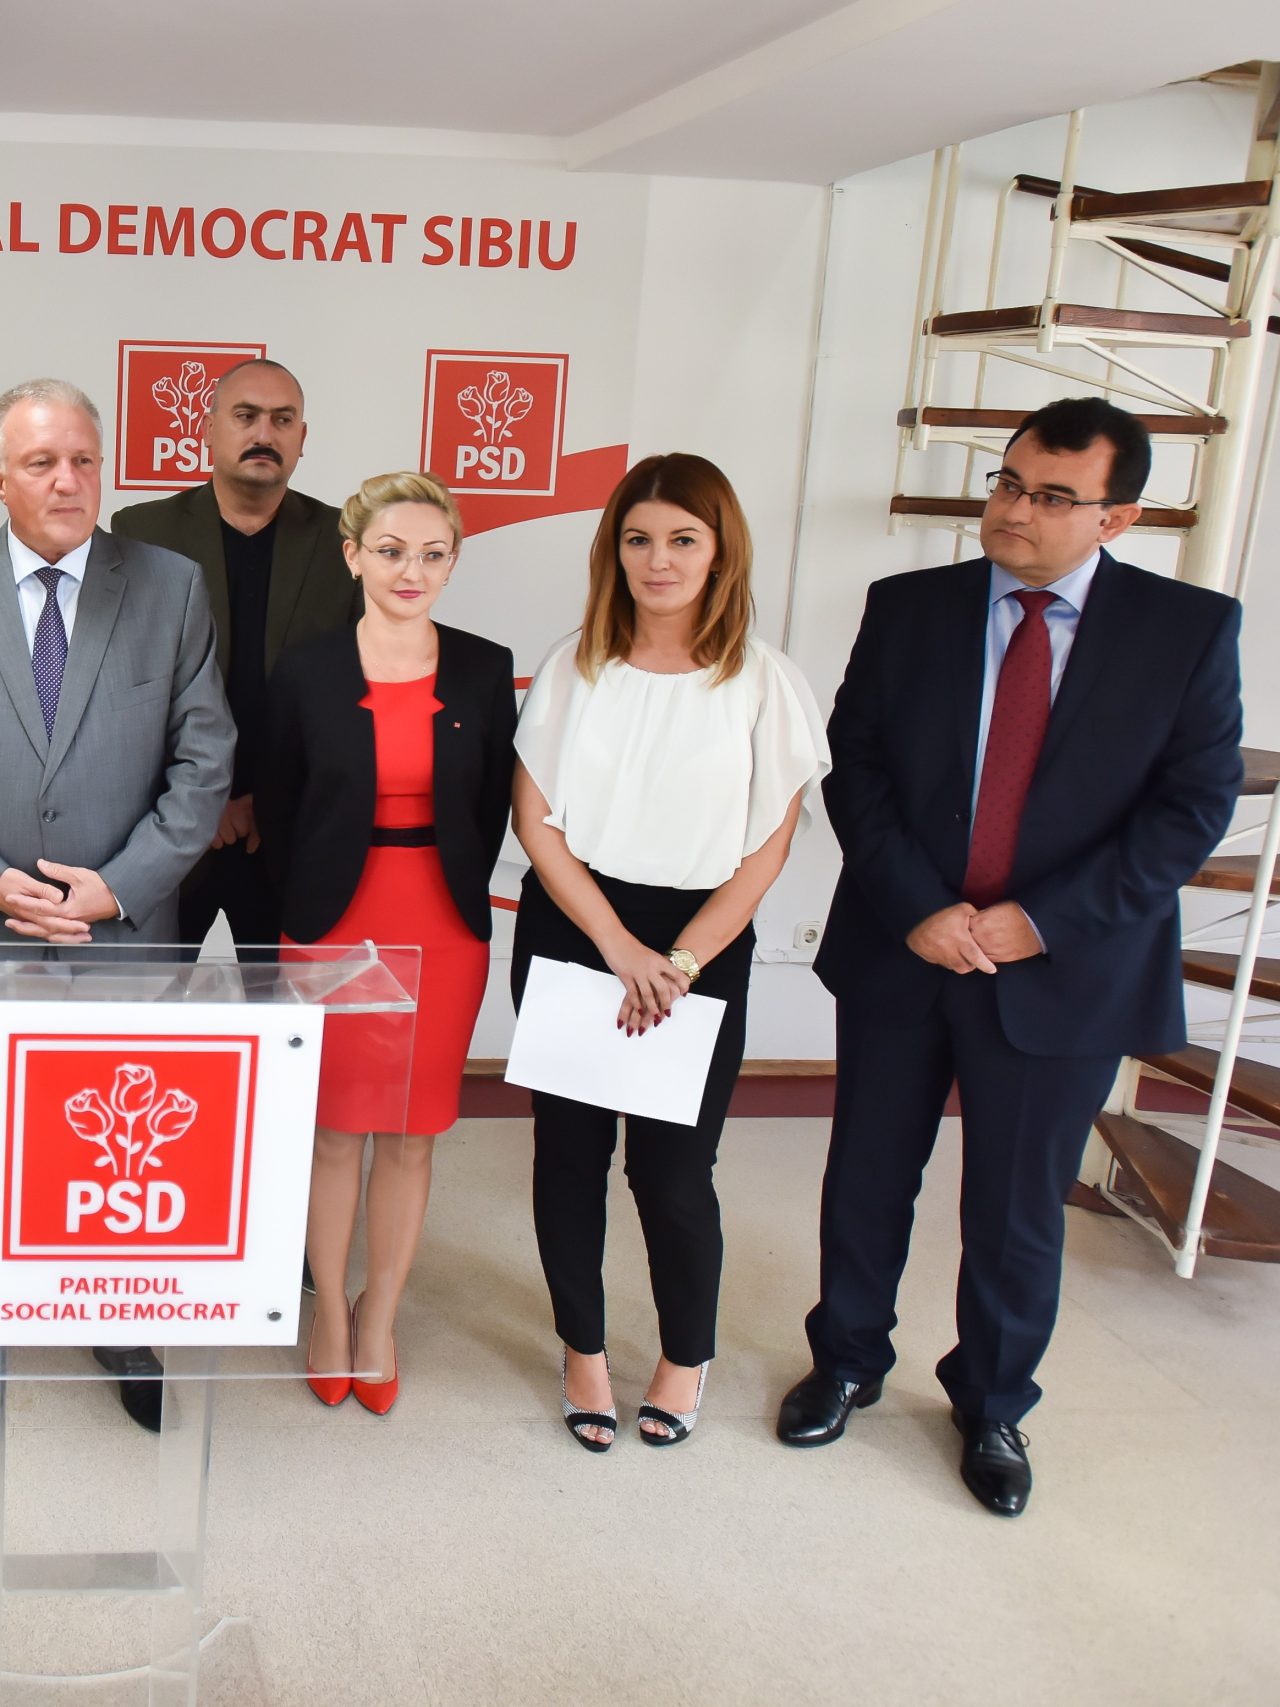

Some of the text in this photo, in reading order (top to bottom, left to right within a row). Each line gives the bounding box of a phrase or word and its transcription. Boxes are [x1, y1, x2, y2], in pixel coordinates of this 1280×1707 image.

[58, 203, 407, 264] DEMOCRAT
[421, 215, 578, 271] SIBIU
[455, 445, 526, 481] PSD
[65, 1179, 187, 1234] PSD
[59, 1276, 184, 1296] PARTIDUL
[0, 1302, 241, 1322] SOCIAL DEMOCRAT
